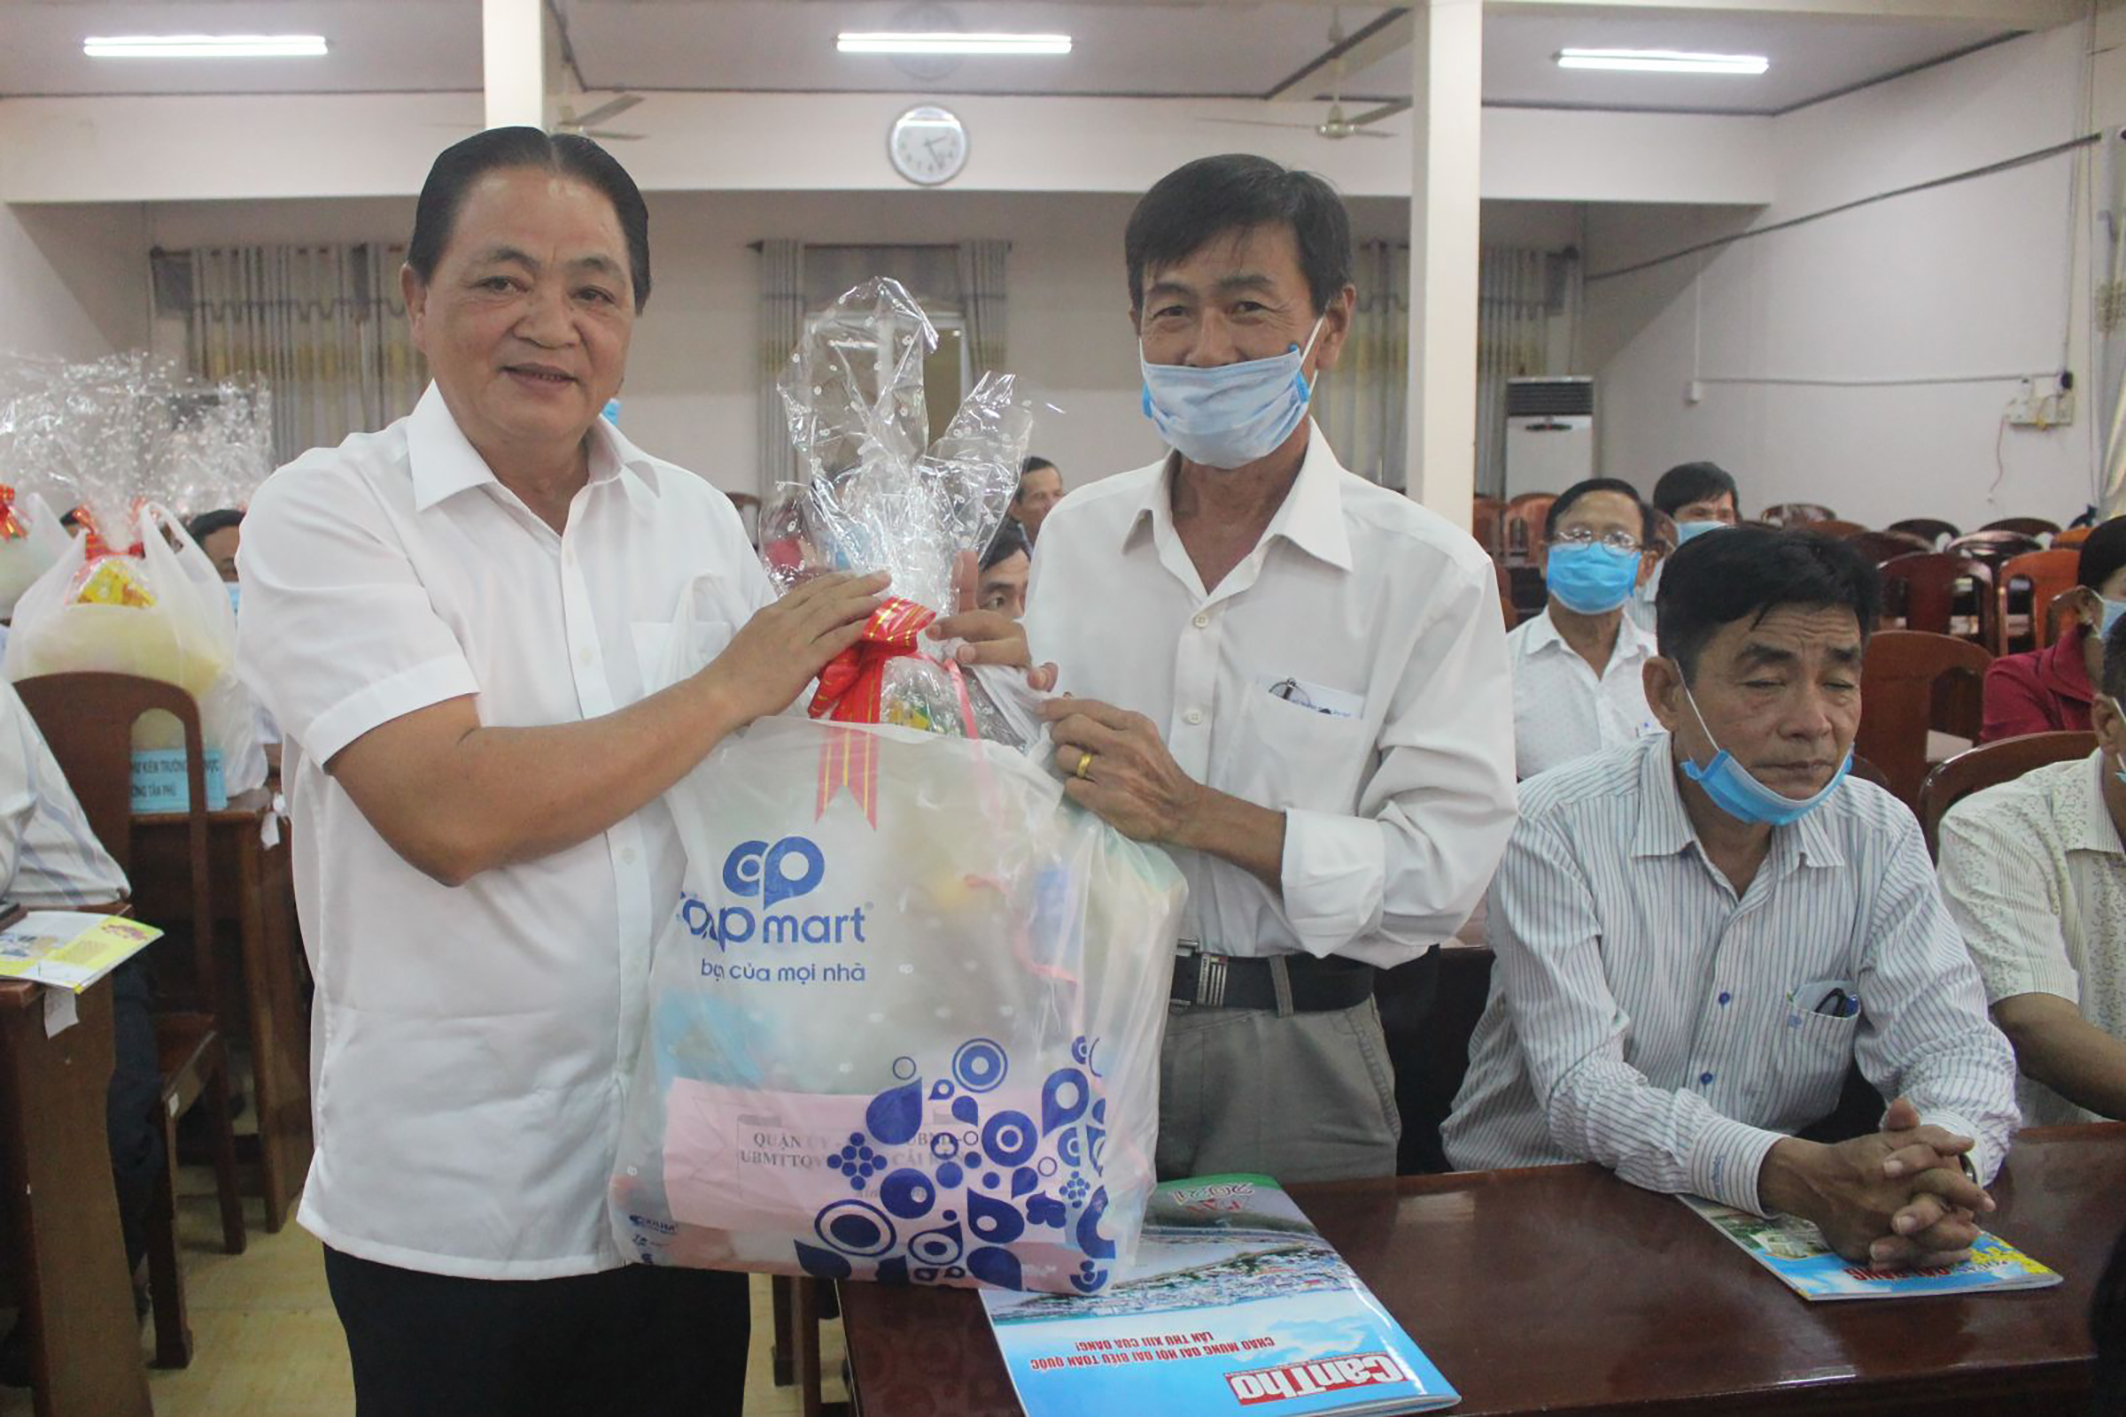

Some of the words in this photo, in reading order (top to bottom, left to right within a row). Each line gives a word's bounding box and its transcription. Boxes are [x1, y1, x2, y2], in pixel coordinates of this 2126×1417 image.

[763, 906, 866, 944] mart
[729, 963, 771, 982] của
[778, 963, 816, 985] mọi
